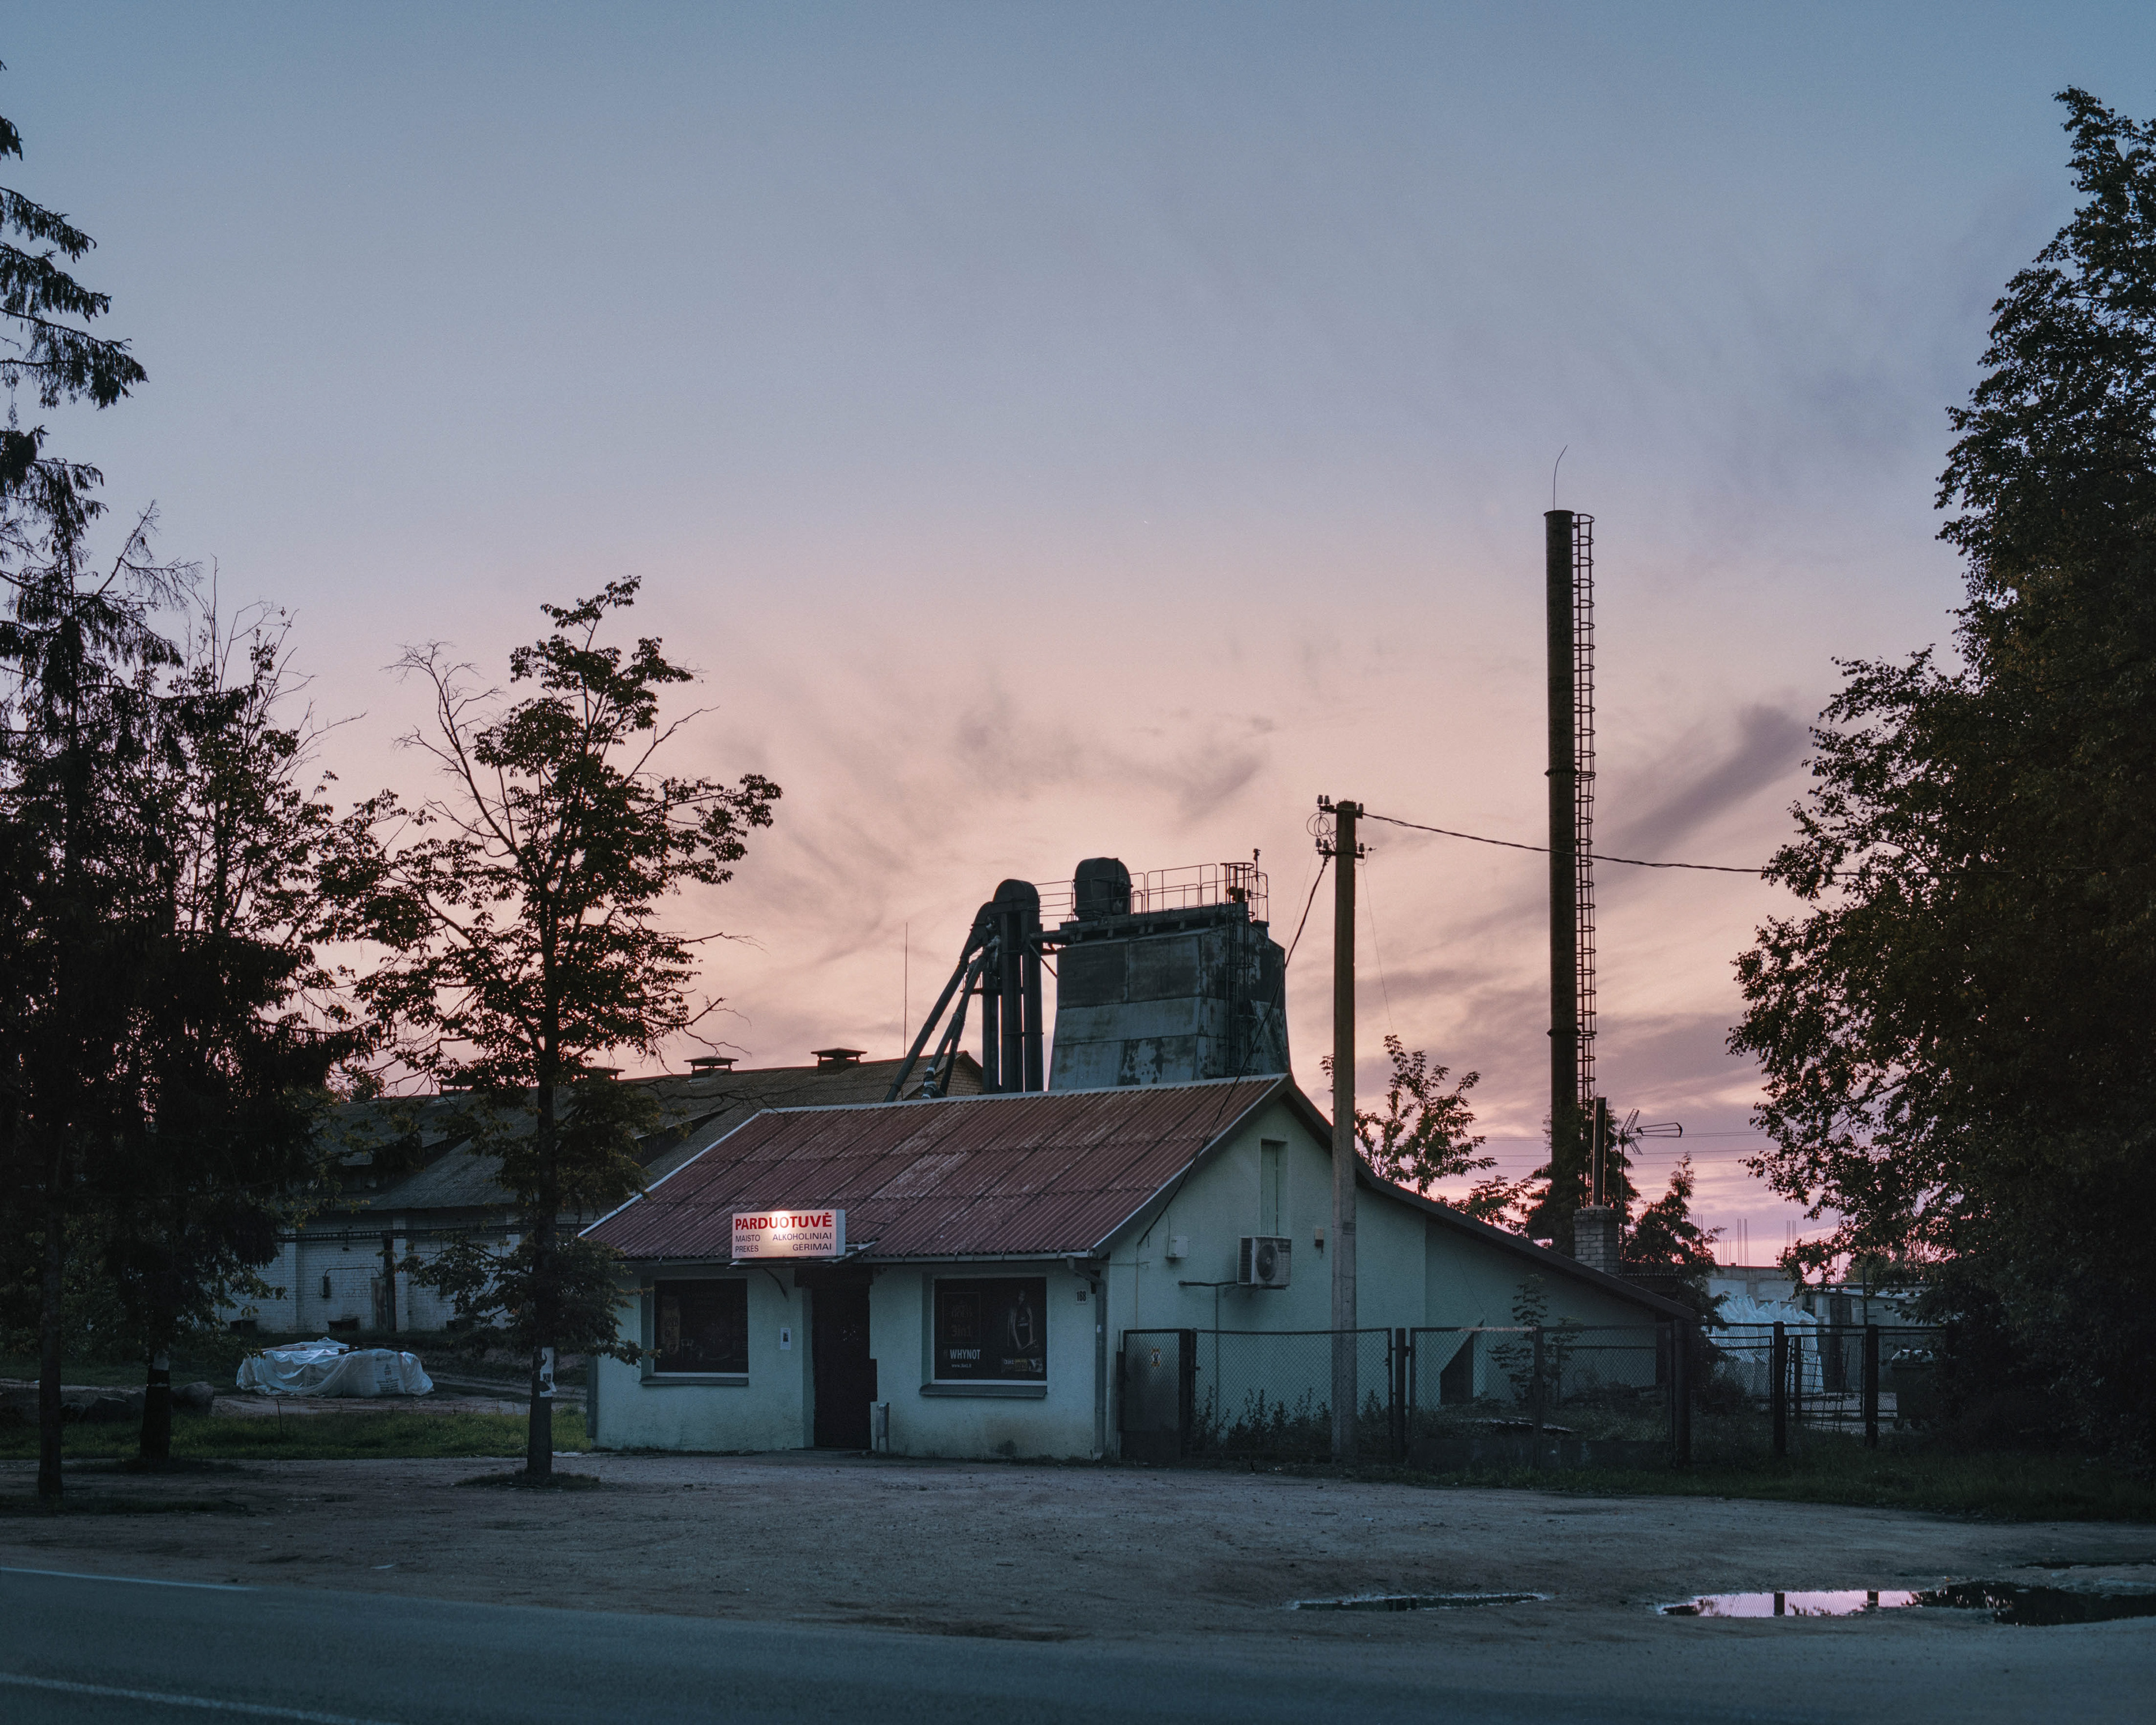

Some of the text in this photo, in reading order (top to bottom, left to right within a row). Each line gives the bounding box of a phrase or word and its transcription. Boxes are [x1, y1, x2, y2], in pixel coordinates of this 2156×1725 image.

[735, 1212, 832, 1230] PARDUOTUVĖ
[735, 1234, 760, 1242] MAISTO
[772, 1232, 832, 1241] ALKOHOLINIAI
[735, 1243, 759, 1252] PREKĖS
[792, 1242, 832, 1251] GĖRIMAI
